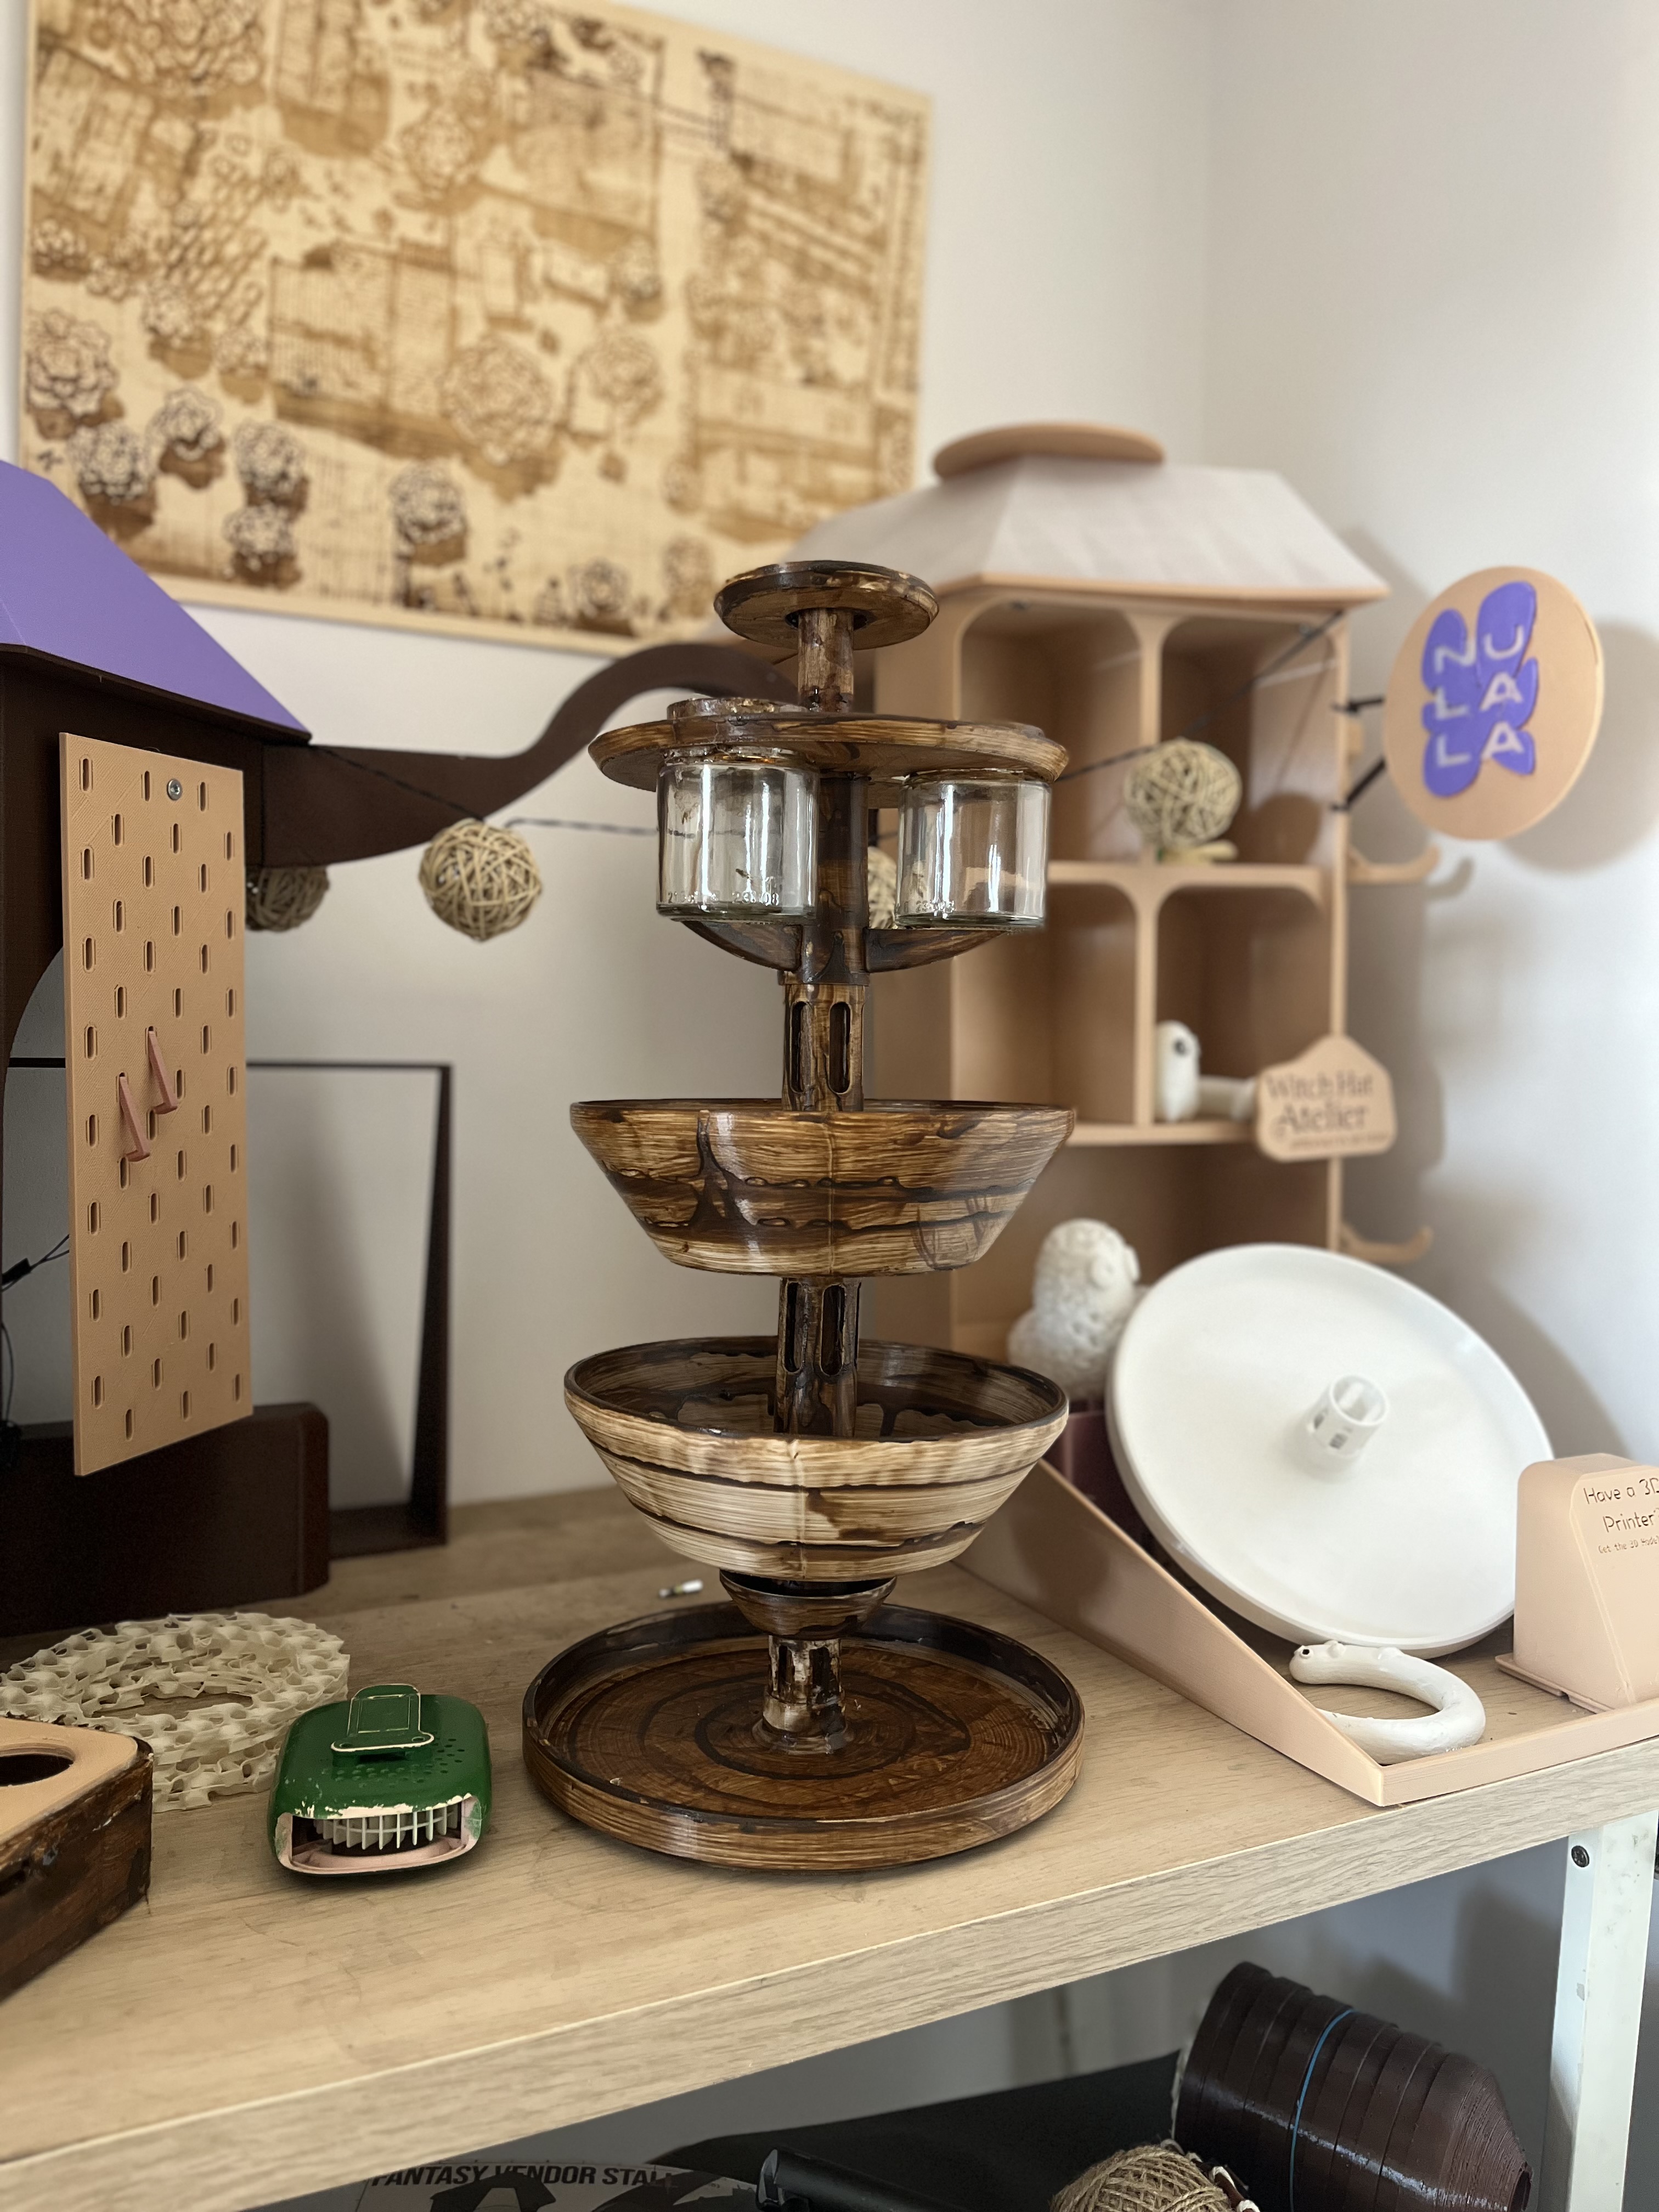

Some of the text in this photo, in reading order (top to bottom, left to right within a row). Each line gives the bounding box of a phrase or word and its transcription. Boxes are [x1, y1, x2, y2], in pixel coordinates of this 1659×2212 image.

[1583, 1477, 1659, 1504] Have a 3D
[1614, 1542, 1627, 1551] the
[1629, 1539, 1639, 1548] 3D
